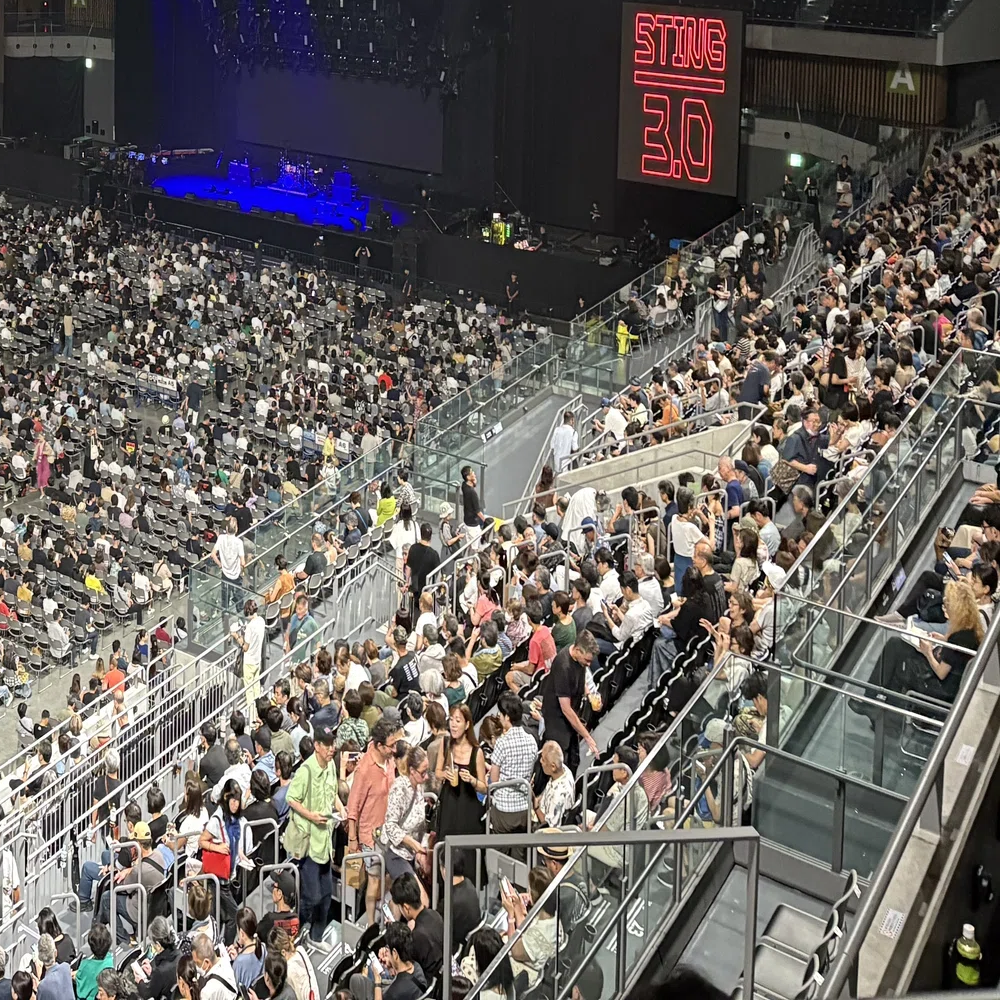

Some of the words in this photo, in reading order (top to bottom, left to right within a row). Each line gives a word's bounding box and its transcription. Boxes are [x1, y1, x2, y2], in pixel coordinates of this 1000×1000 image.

[634, 12, 727, 72] STING
[889, 62, 915, 92] A
[641, 93, 714, 184] 3.0
